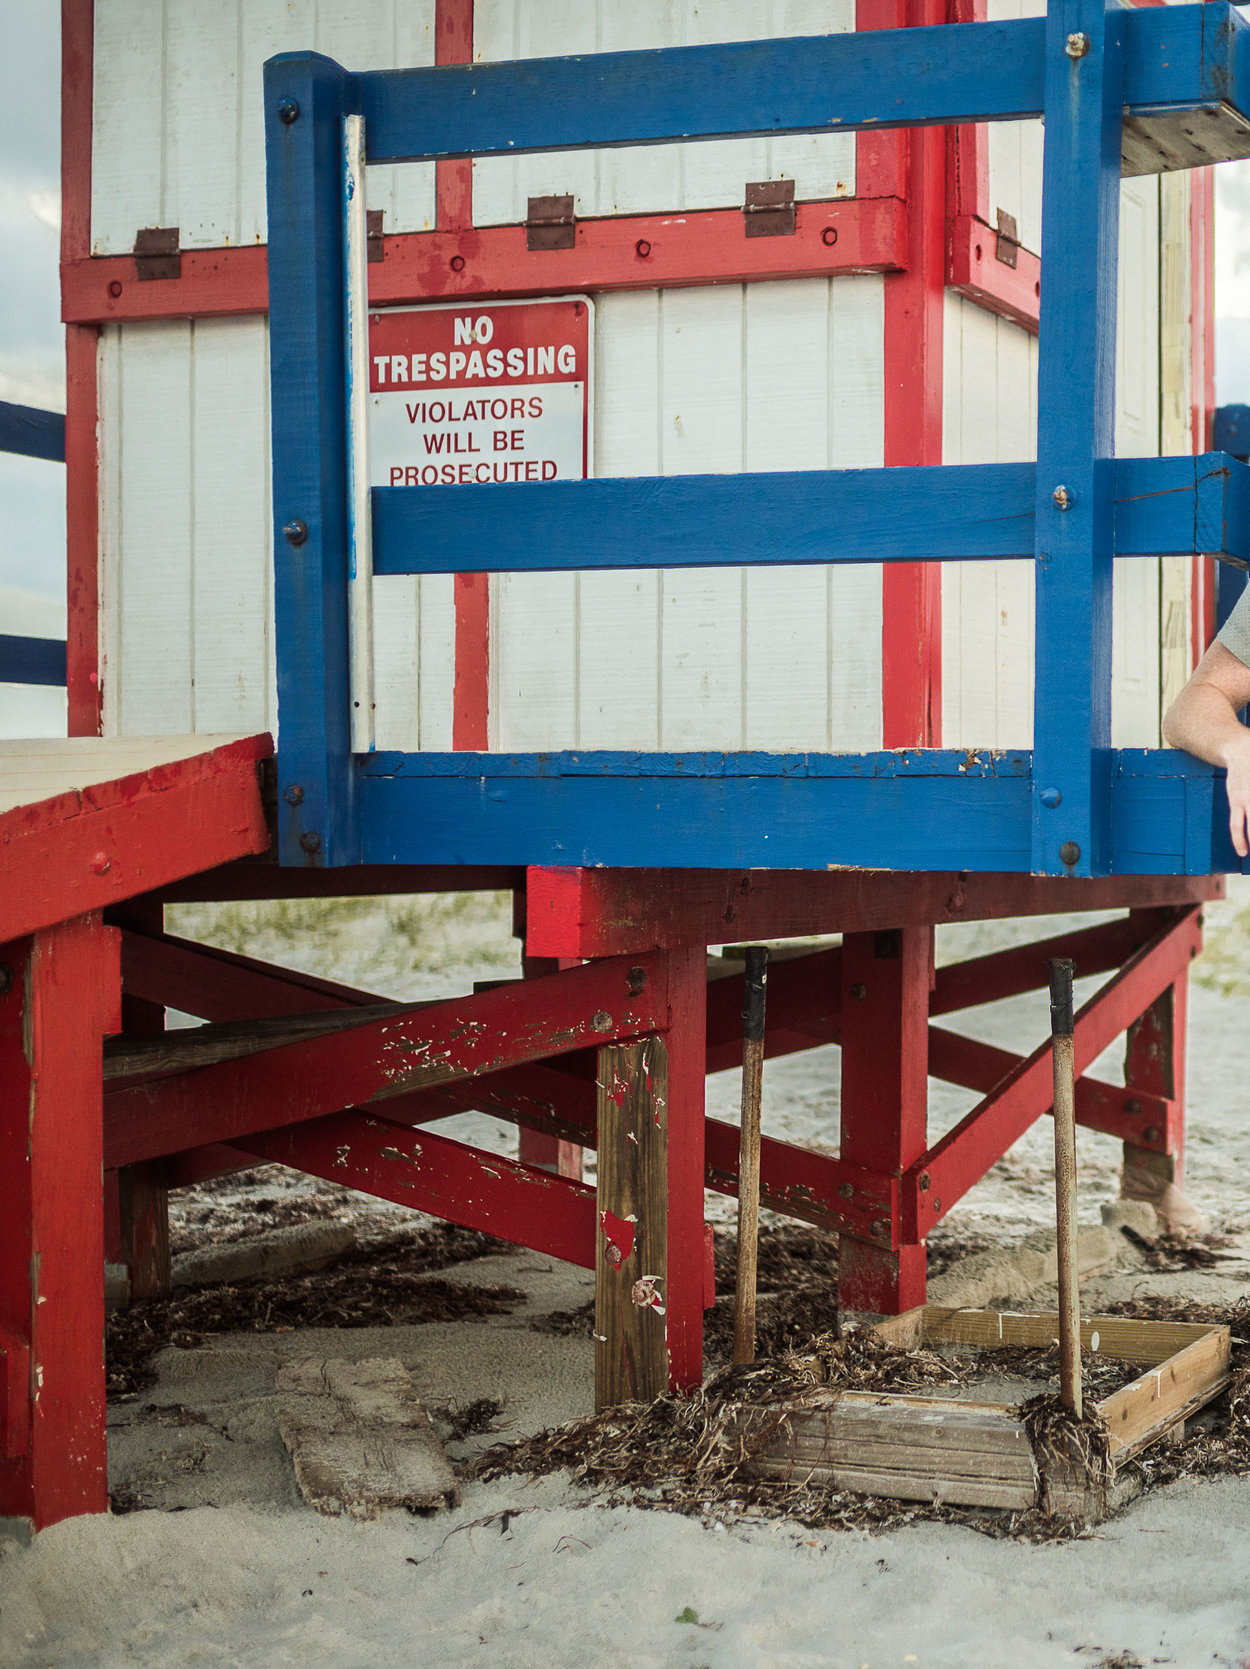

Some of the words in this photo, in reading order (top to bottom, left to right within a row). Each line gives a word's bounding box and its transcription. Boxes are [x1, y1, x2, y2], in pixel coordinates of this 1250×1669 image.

[454, 315, 494, 346] NO
[373, 344, 577, 384] TRESPASSING
[405, 397, 543, 424] VIOLATORS
[423, 432, 481, 455] WILL
[493, 429, 525, 451] BE
[389, 460, 558, 487] PROSECUTED
